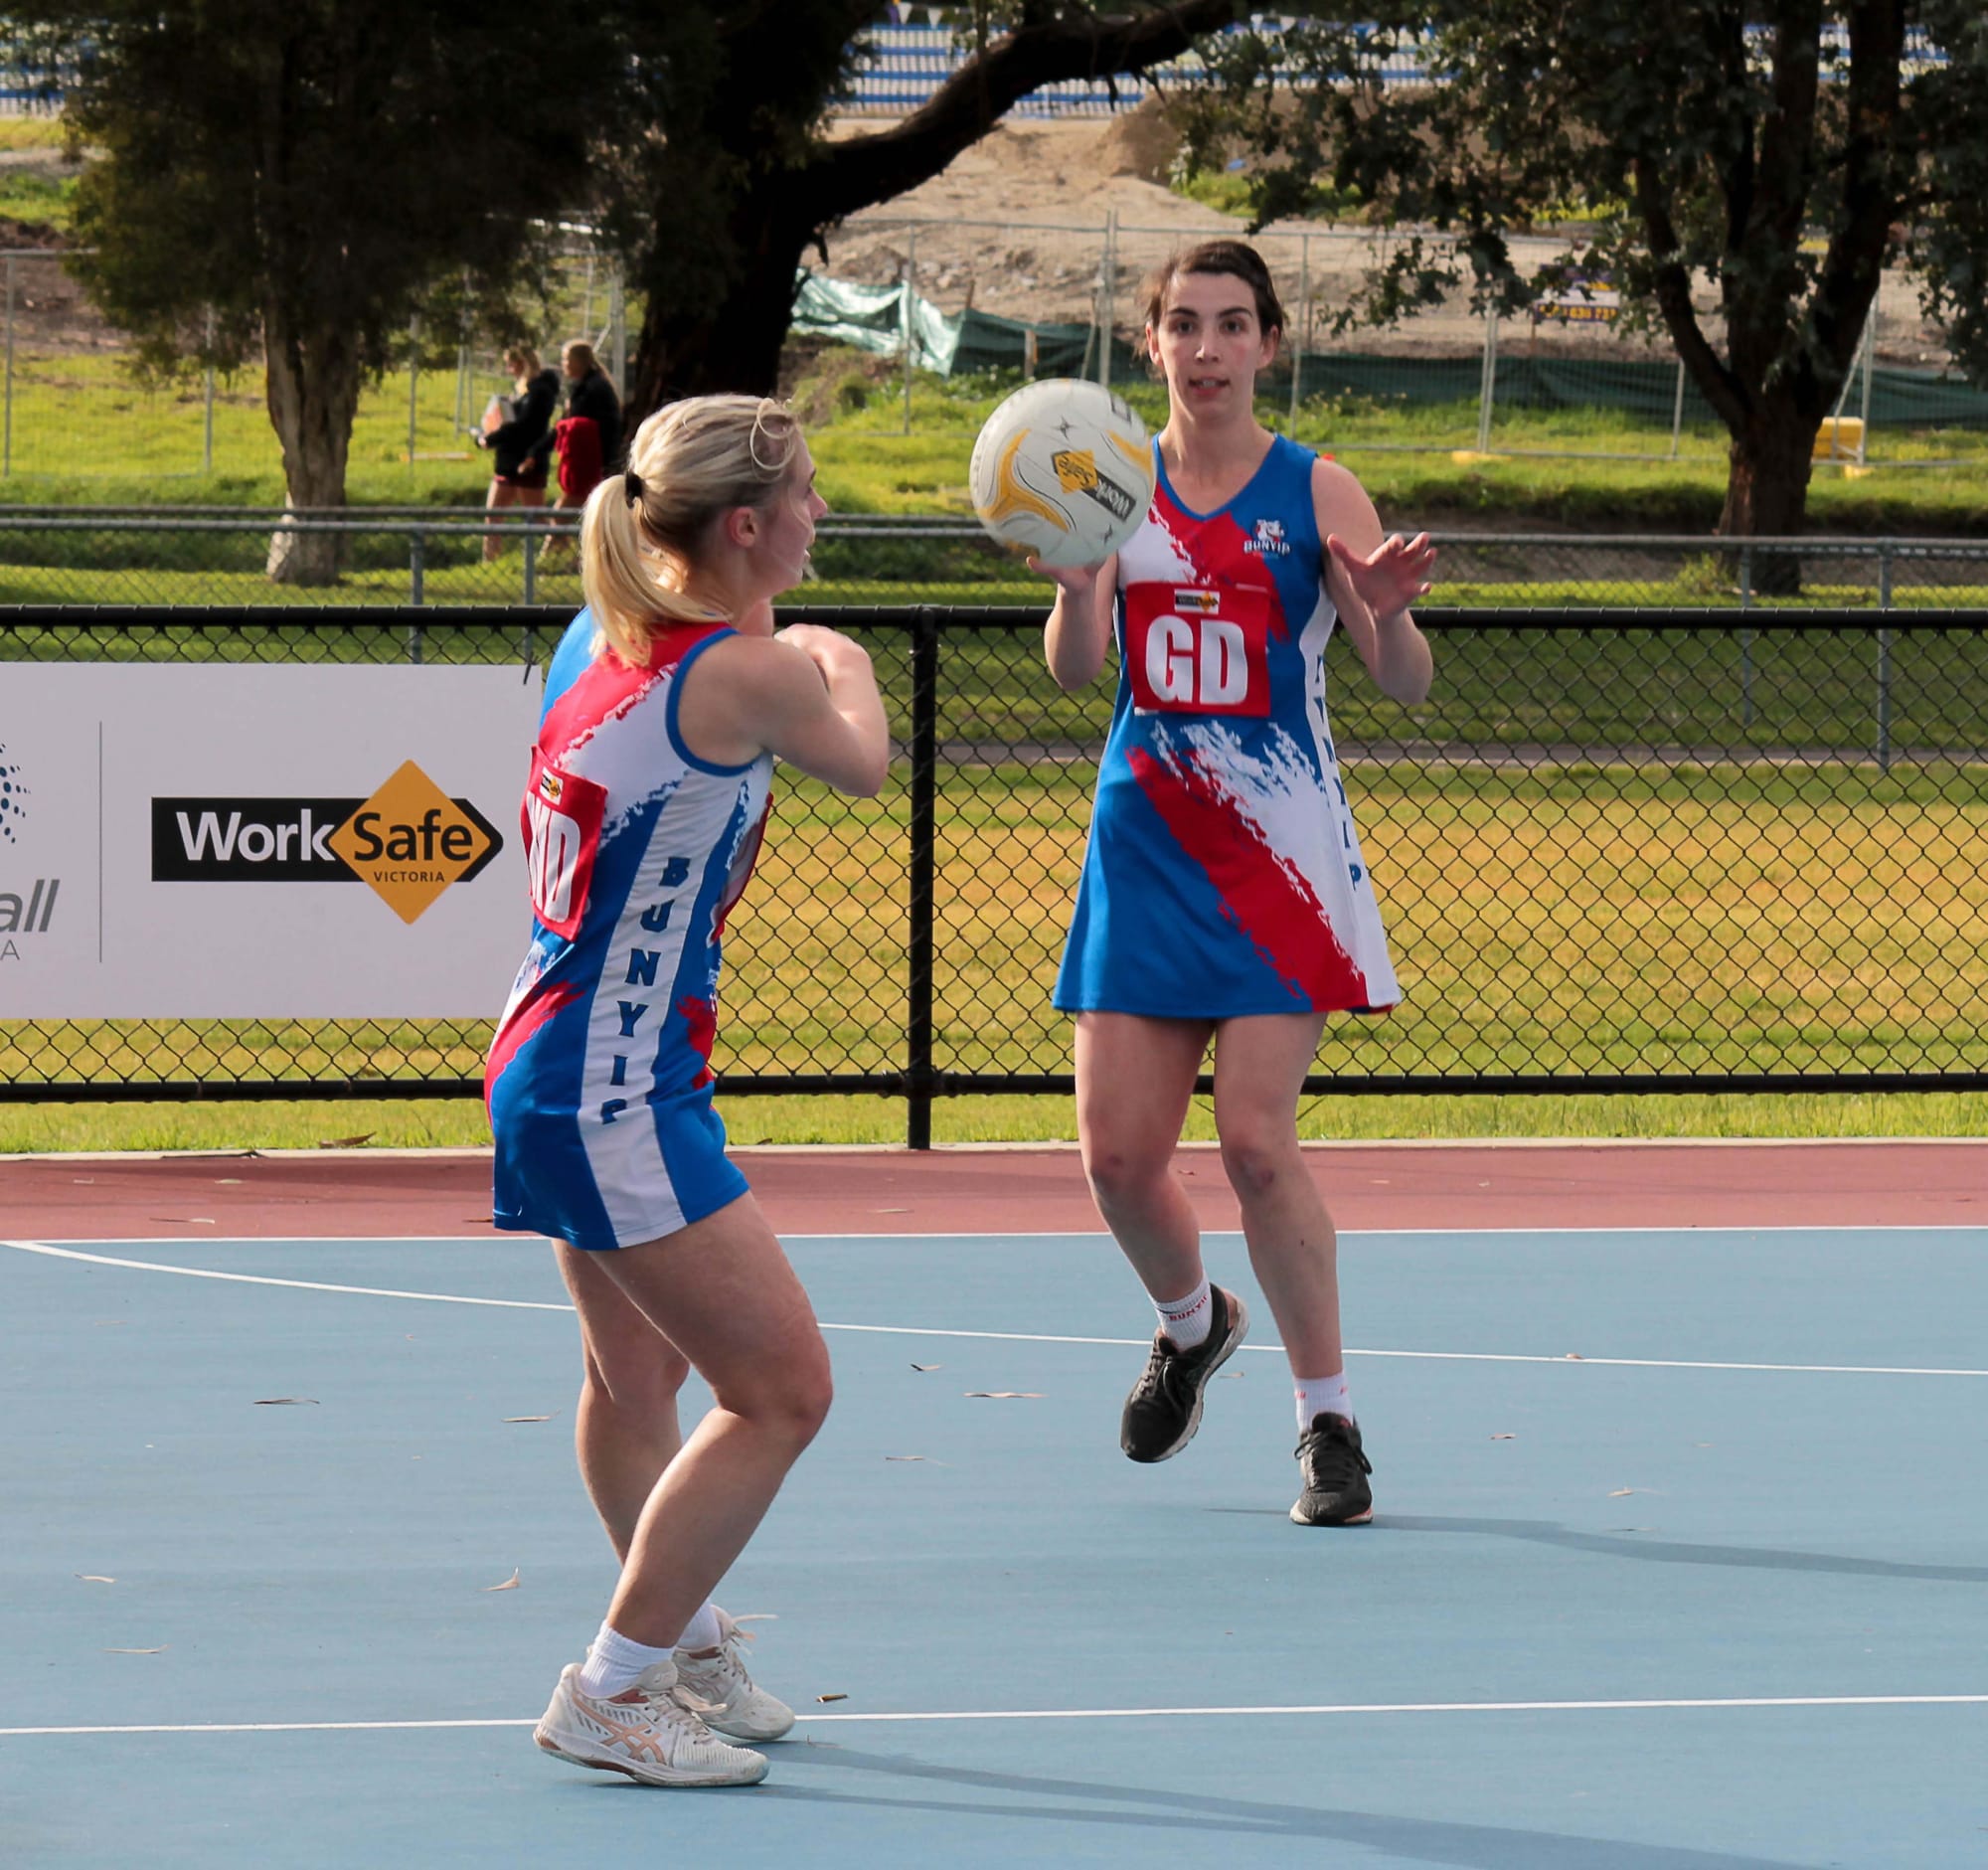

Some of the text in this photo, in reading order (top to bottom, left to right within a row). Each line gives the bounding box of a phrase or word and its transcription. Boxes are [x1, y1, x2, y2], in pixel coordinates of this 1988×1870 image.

[1094, 477, 1130, 518] Work
[1145, 614, 1248, 705] GD
[176, 808, 473, 862] Work Safe
[373, 871, 445, 883] VICTORIA
[600, 857, 691, 1125] BUNYIP
